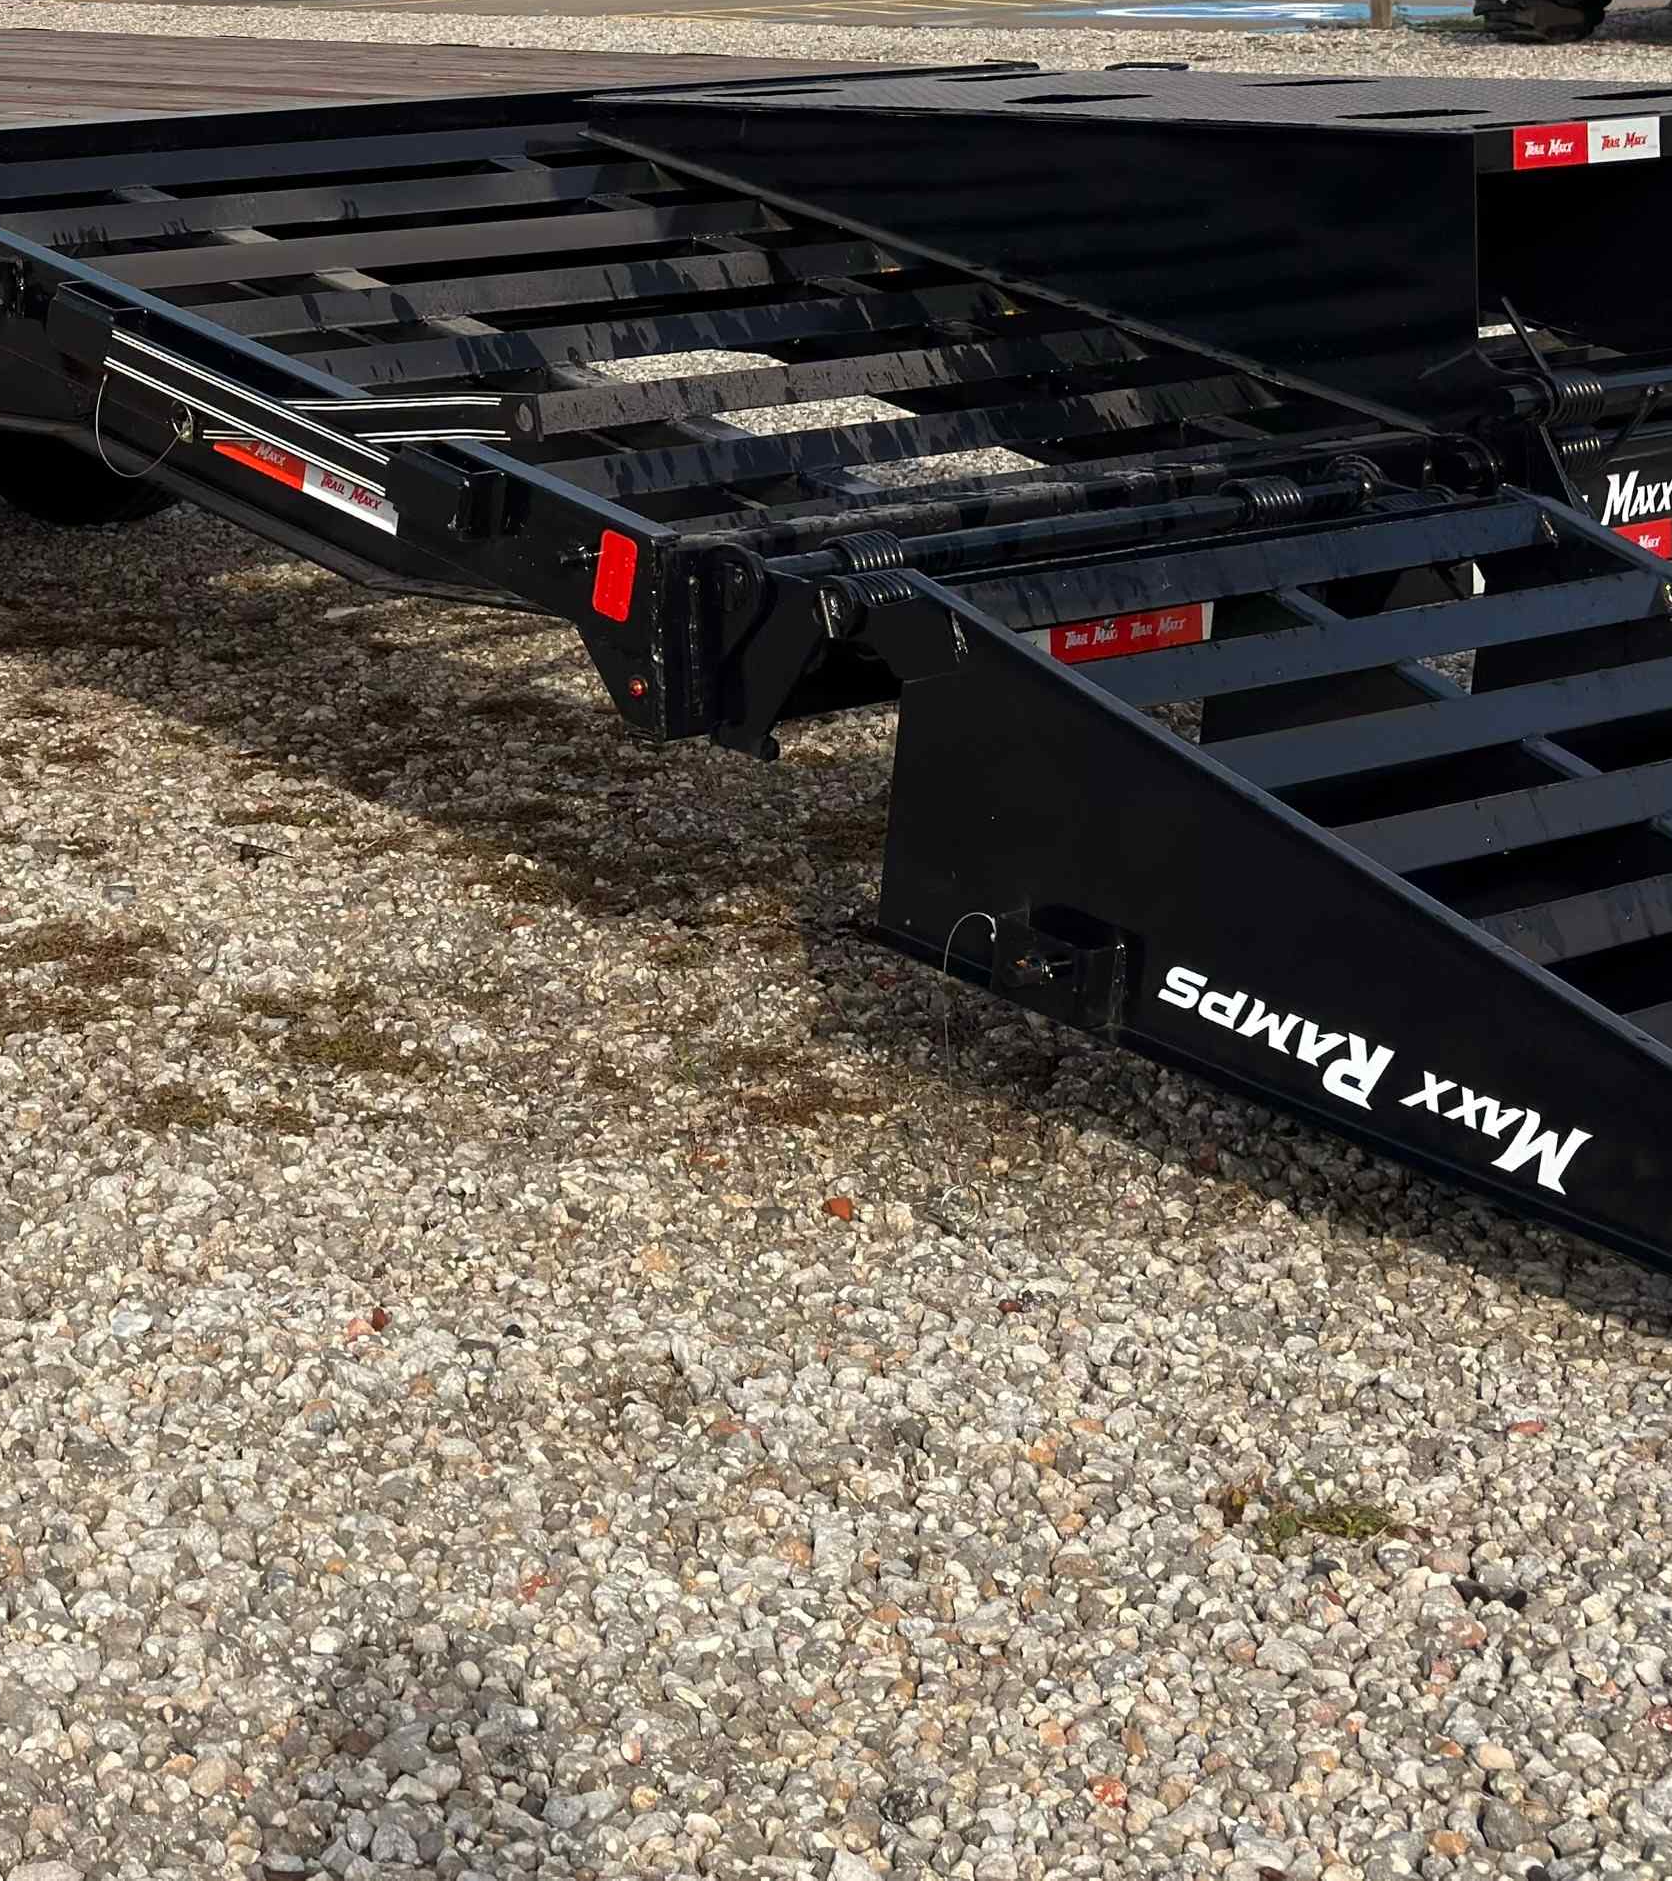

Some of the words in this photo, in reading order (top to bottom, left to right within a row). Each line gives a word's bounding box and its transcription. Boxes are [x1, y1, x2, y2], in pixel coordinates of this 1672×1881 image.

[1524, 141, 1545, 157] TRAIL
[1548, 138, 1573, 156] MAXX
[320, 471, 345, 495] TRAIL
[349, 485, 383, 511] MAXX
[1157, 965, 1396, 1111] RAMPS
[1397, 1069, 1594, 1196] MAXX
